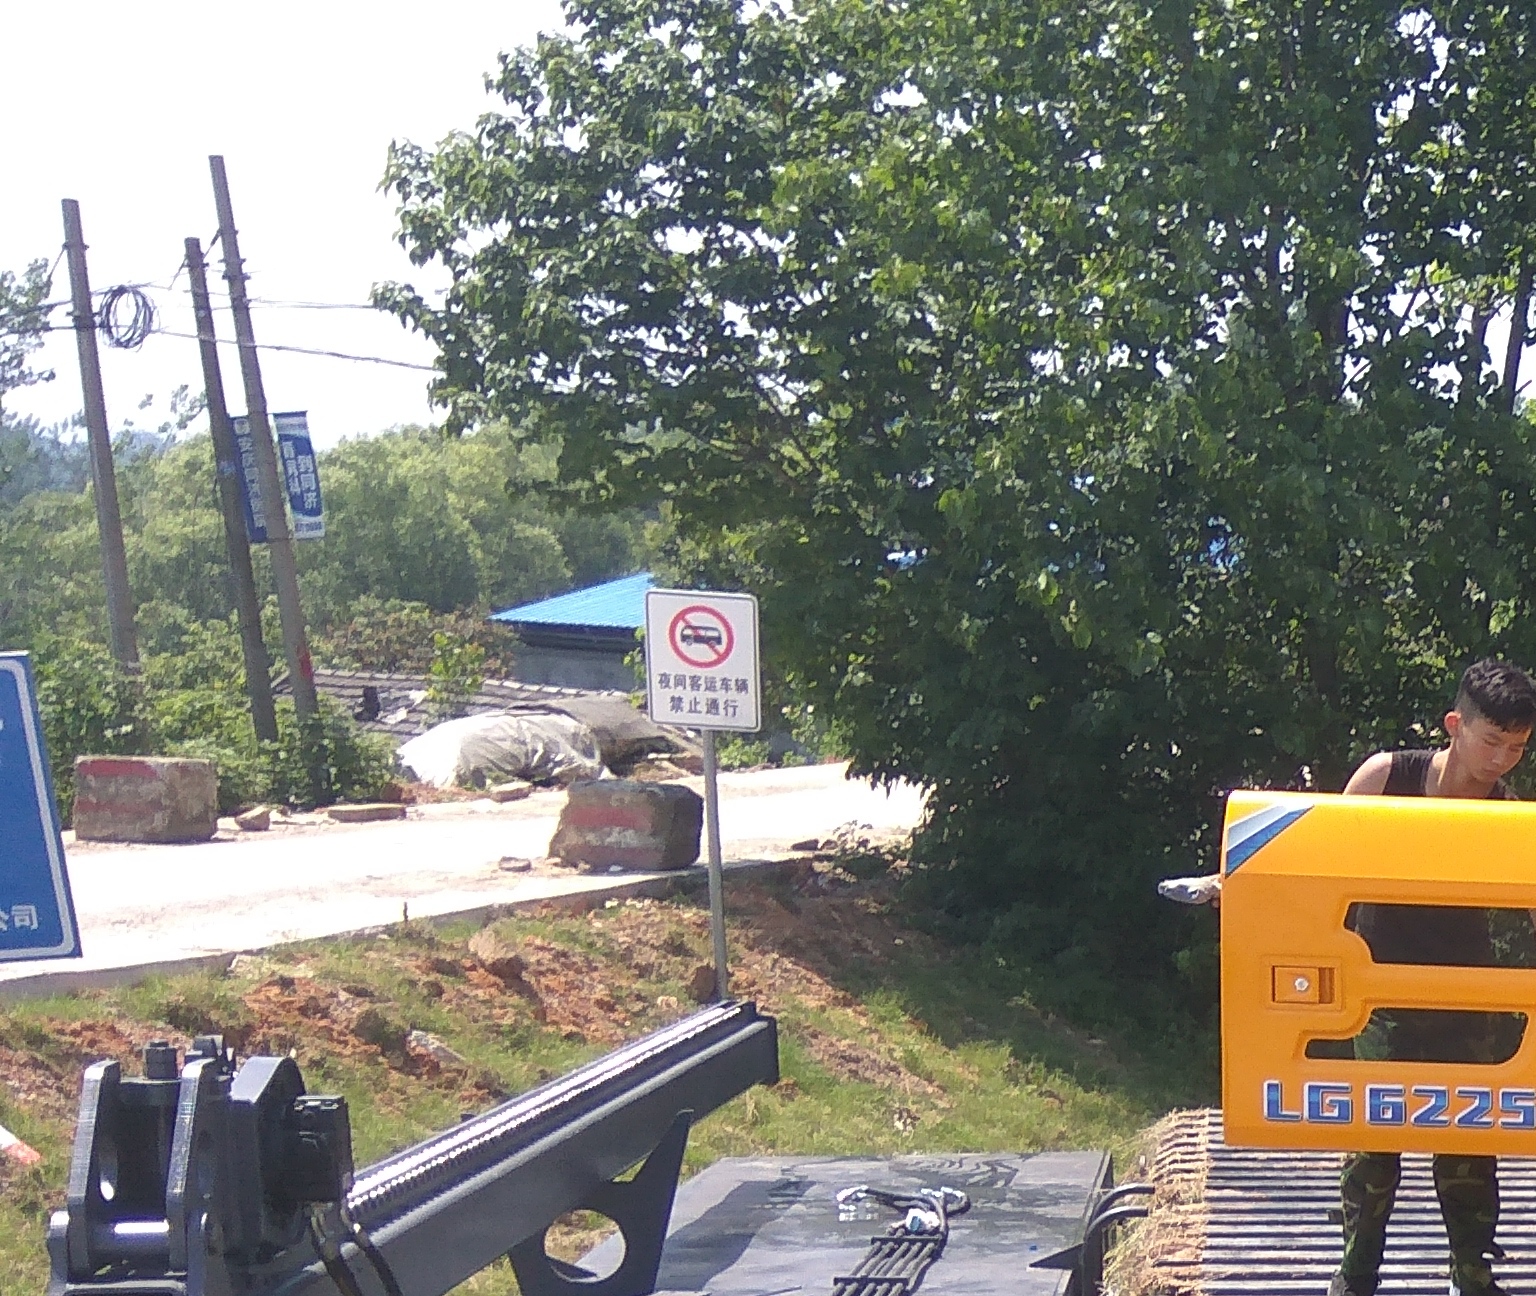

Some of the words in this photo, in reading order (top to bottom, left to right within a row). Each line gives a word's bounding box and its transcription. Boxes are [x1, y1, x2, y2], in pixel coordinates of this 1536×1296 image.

[658, 672, 749, 694] 夜间客运车辆
[669, 695, 739, 718] 禁止通行
